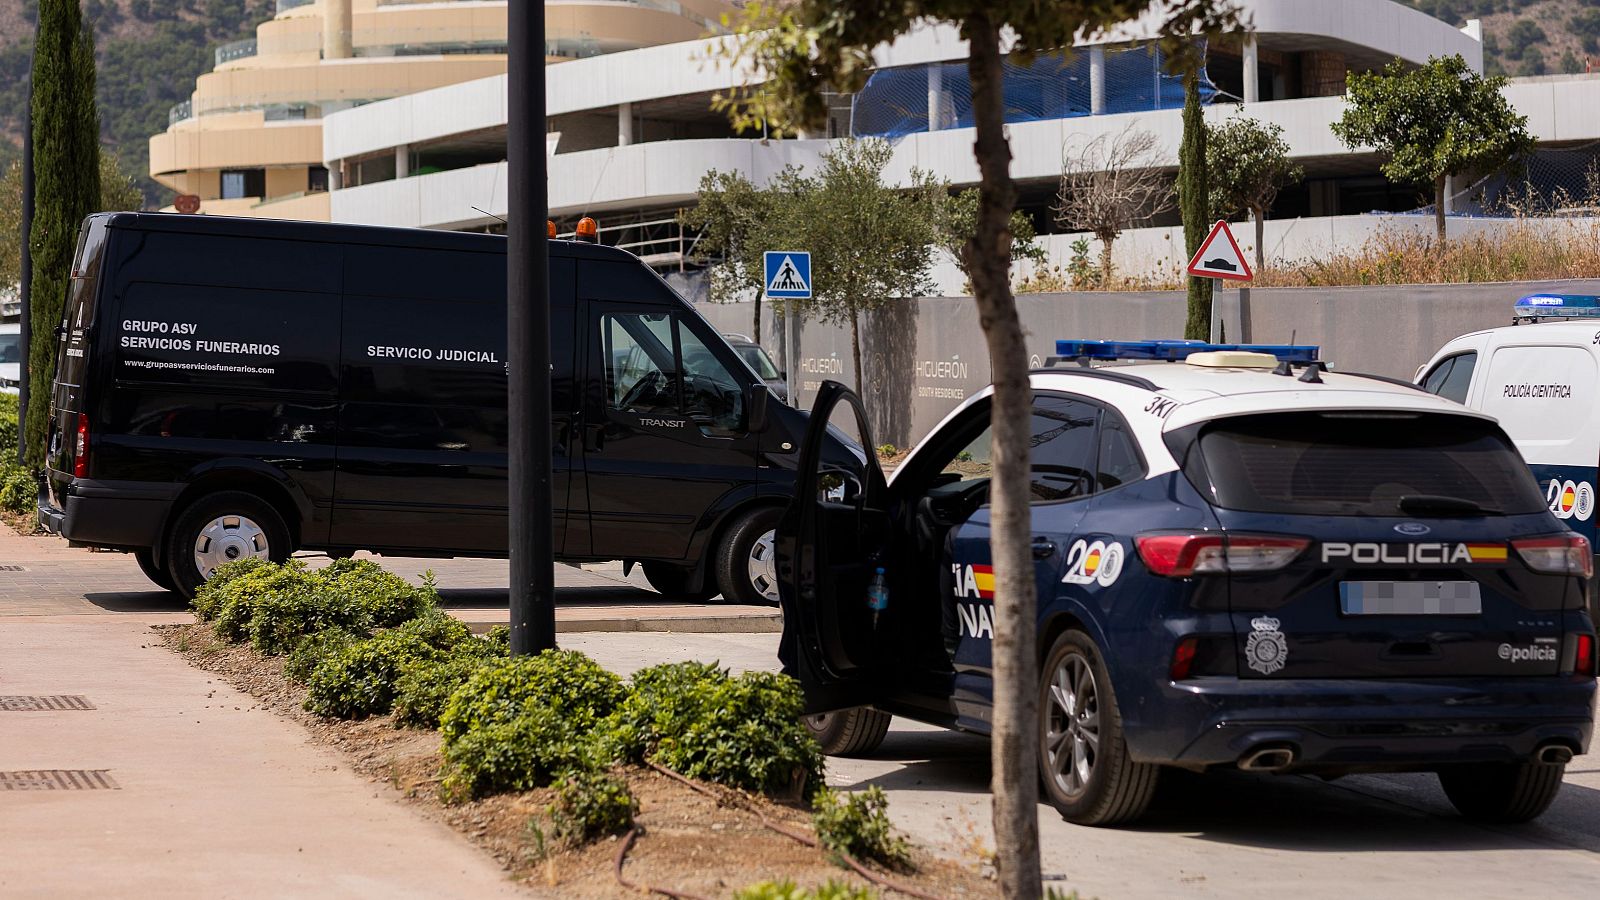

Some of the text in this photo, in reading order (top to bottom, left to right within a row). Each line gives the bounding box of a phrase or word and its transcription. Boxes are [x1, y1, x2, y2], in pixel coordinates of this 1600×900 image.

[122, 320, 197, 335] GRUPO ASV
[121, 336, 280, 356] SERVICIOS FUNERARIOS
[367, 345, 499, 363] SERVICIO JUDICIAL
[124, 360, 275, 375] www.grupoasvserviciosfunerarios.com
[640, 418, 686, 428] TRANSIT
